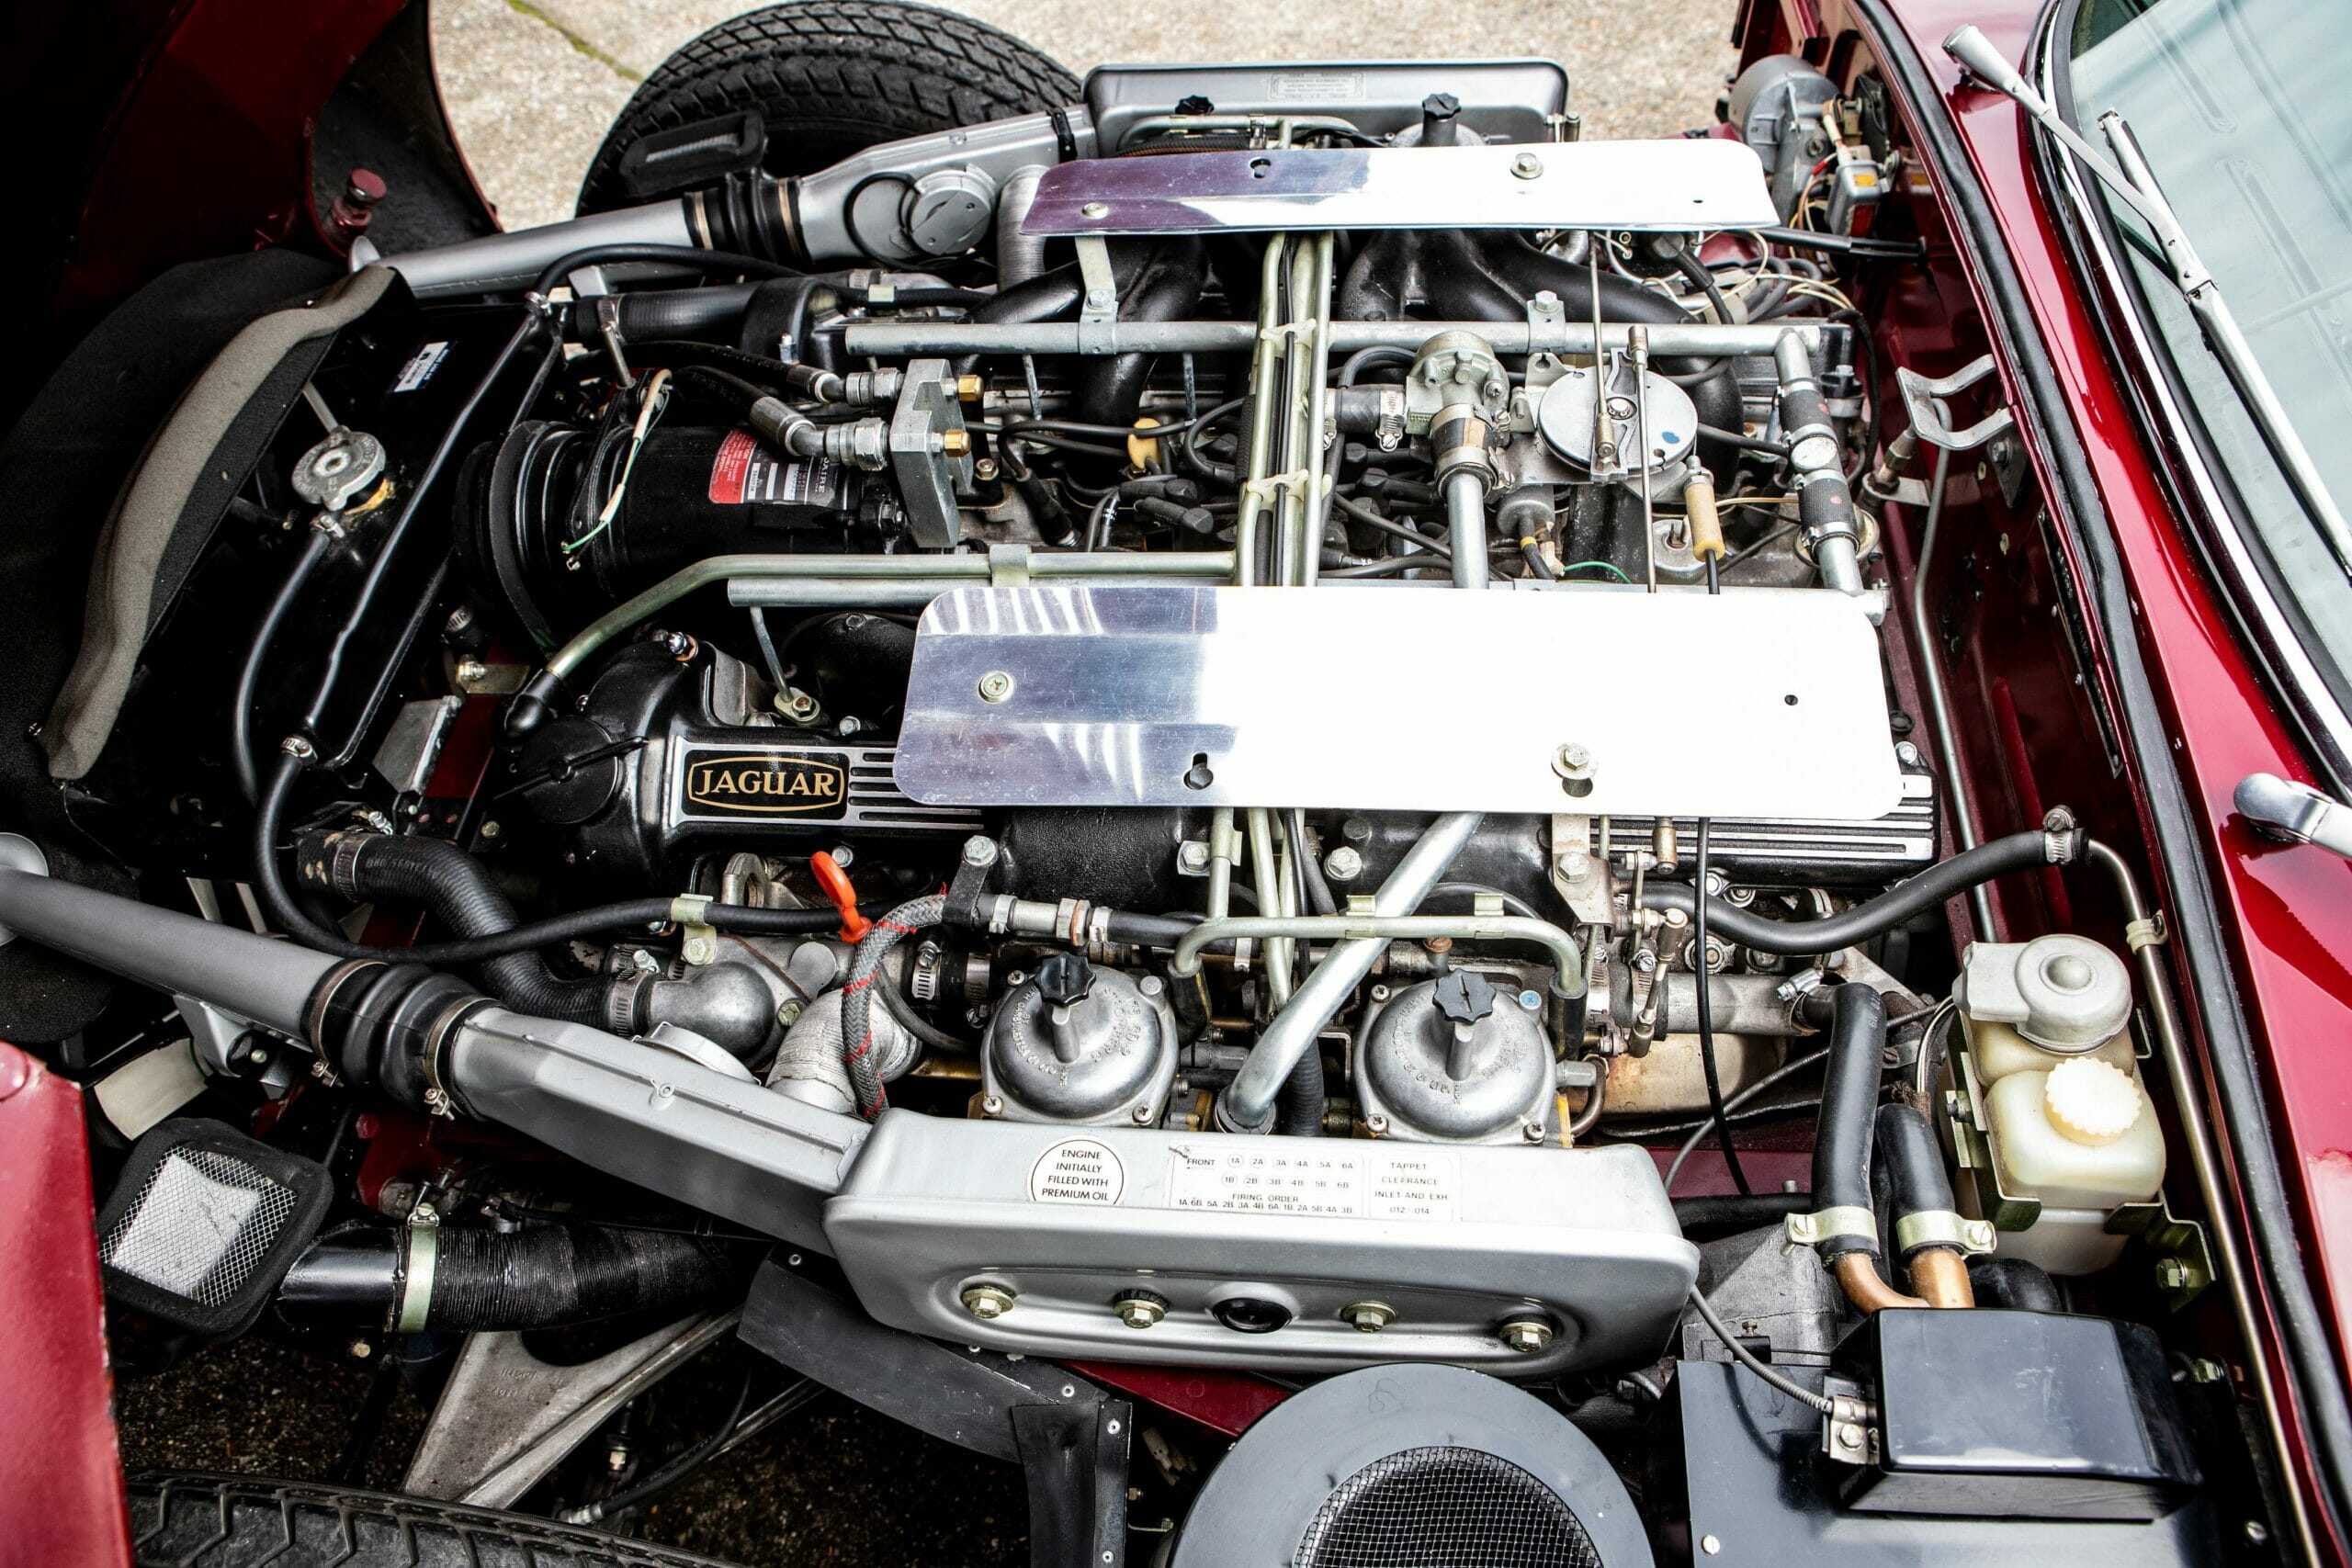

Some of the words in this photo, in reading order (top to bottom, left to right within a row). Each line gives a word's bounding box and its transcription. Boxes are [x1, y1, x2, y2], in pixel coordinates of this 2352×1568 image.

[695, 770, 837, 796] JAGUAR
[1061, 1149, 1102, 1159] ENGINE
[1056, 1162, 1102, 1173] INITIALLY
[1186, 1157, 1216, 1167] FRONT
[1390, 1162, 1427, 1170] TAPPET
[1047, 1175, 1080, 1185] FILLED
[1081, 1178, 1109, 1187] WITH
[1381, 1176, 1439, 1186] CLEARANCE
[1041, 1188, 1091, 1200] PREMIUM
[1091, 1191, 1109, 1201] OIL
[1374, 1190, 1401, 1199] INLET
[1430, 1192, 1448, 1201] EXH
